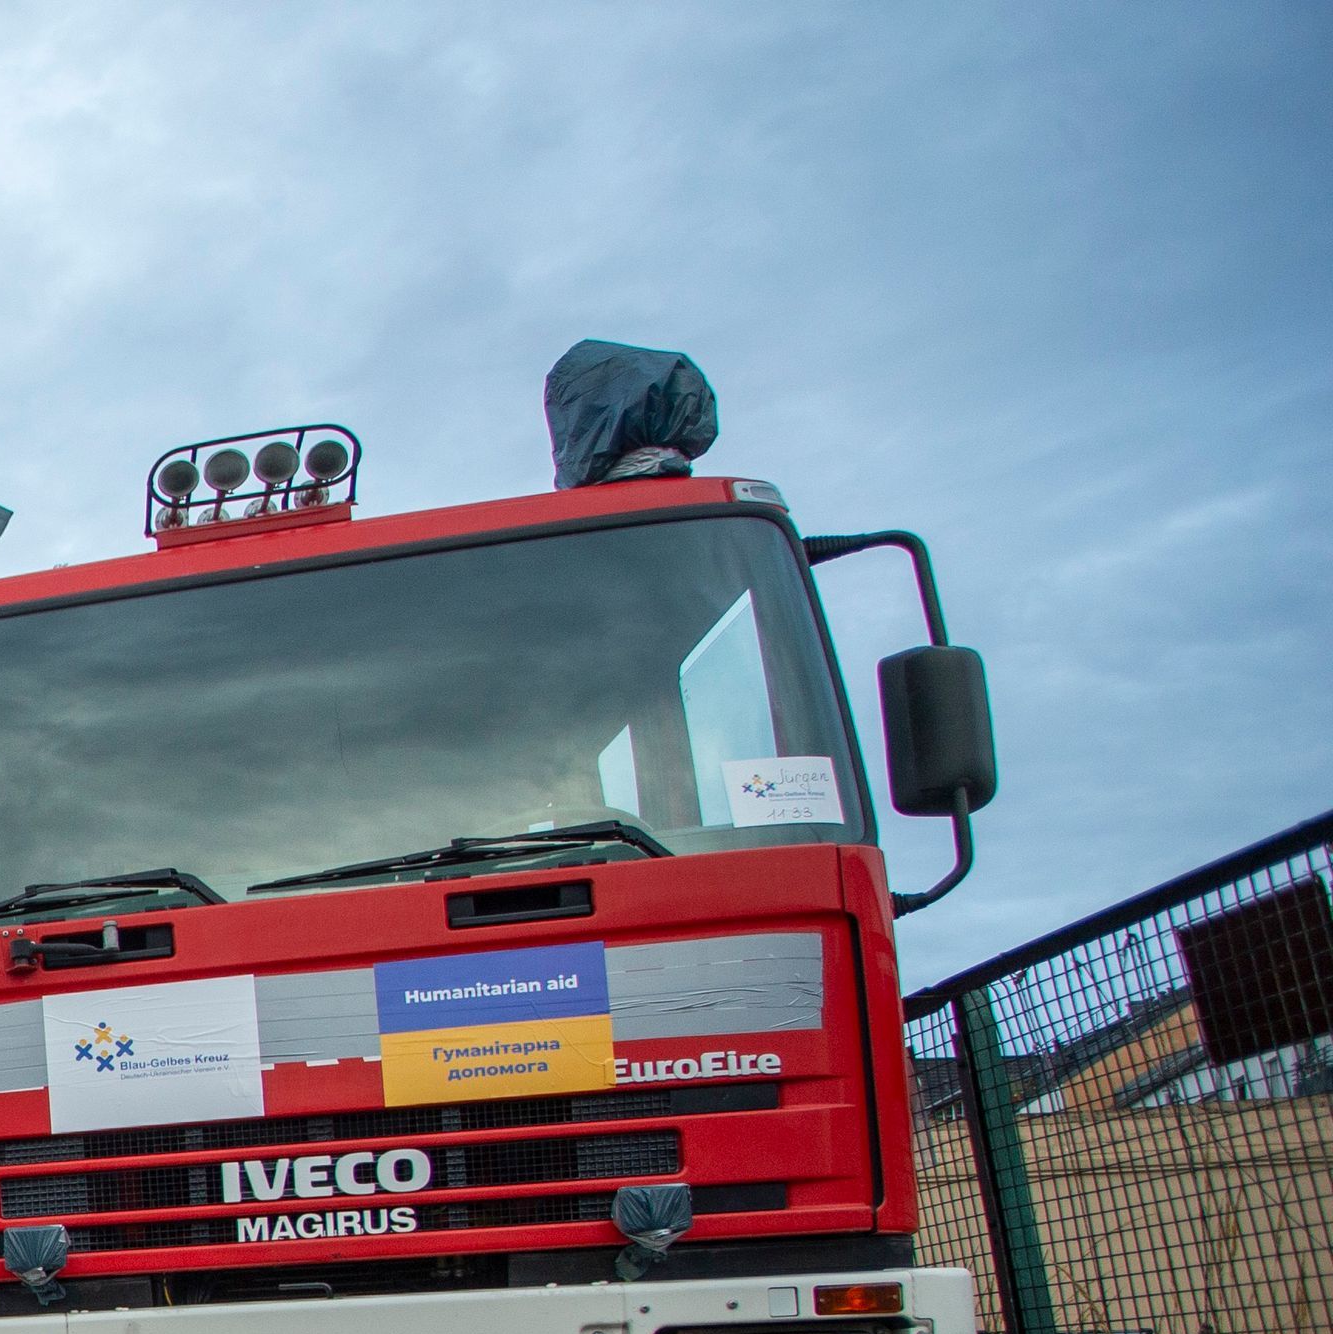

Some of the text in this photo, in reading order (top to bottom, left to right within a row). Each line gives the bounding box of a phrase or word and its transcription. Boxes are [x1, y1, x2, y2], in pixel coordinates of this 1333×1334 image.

[776, 769, 829, 791] Jürgen
[404, 975, 578, 1004] Humanitarian aid
[120, 1053, 229, 1071] Blau-Gelbes Kreuz
[433, 1039, 560, 1062] Гуманітарна
[448, 1061, 548, 1081] допомога
[221, 1148, 431, 1203] IVECO
[236, 1207, 417, 1243] MAGIRUS
